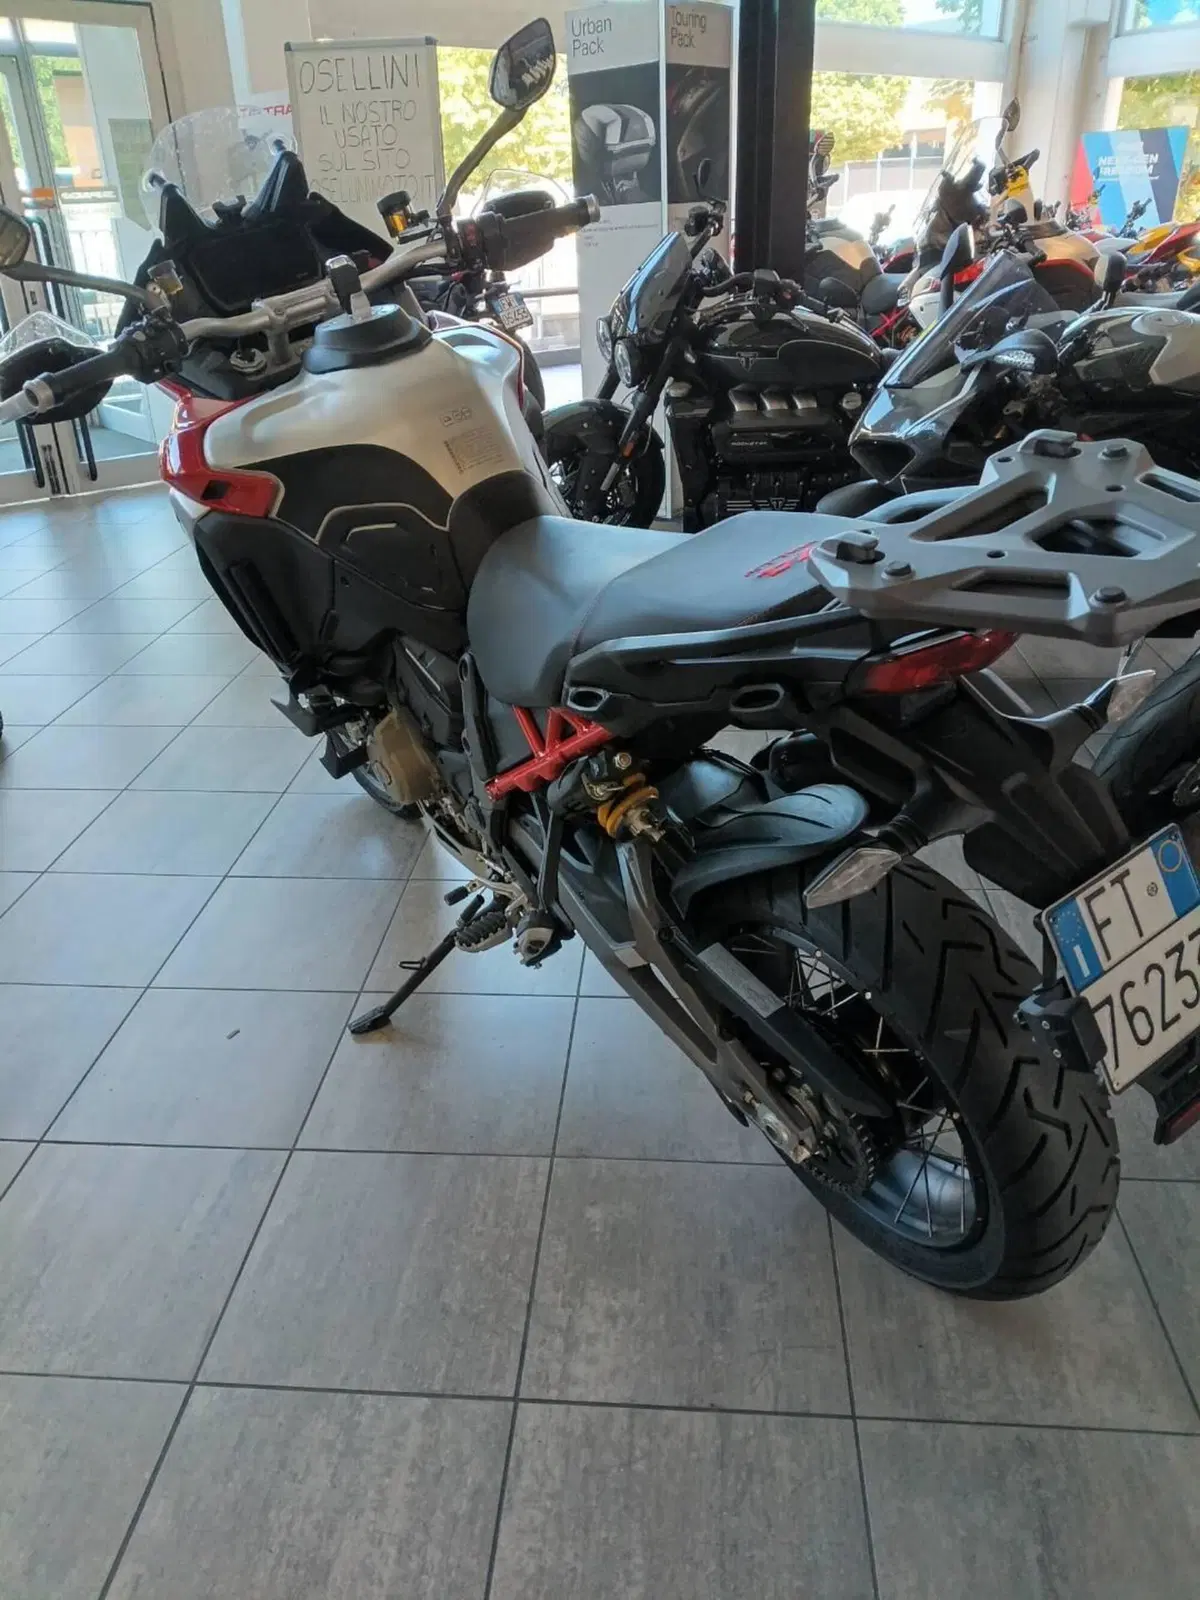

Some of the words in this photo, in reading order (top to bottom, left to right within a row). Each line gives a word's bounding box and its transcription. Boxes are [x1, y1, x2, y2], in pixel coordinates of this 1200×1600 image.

[571, 16, 612, 38] Urban
[670, 5, 707, 33] Touring
[572, 38, 605, 58] Pack
[670, 27, 697, 49] Pack
[300, 53, 421, 94] OSELLINI
[319, 104, 333, 126] IL
[342, 99, 417, 125] NOSTRO
[333, 123, 398, 149] USATO
[318, 152, 356, 172] SUL
[361, 147, 411, 171] SITO
[1084, 869, 1143, 962] FT
